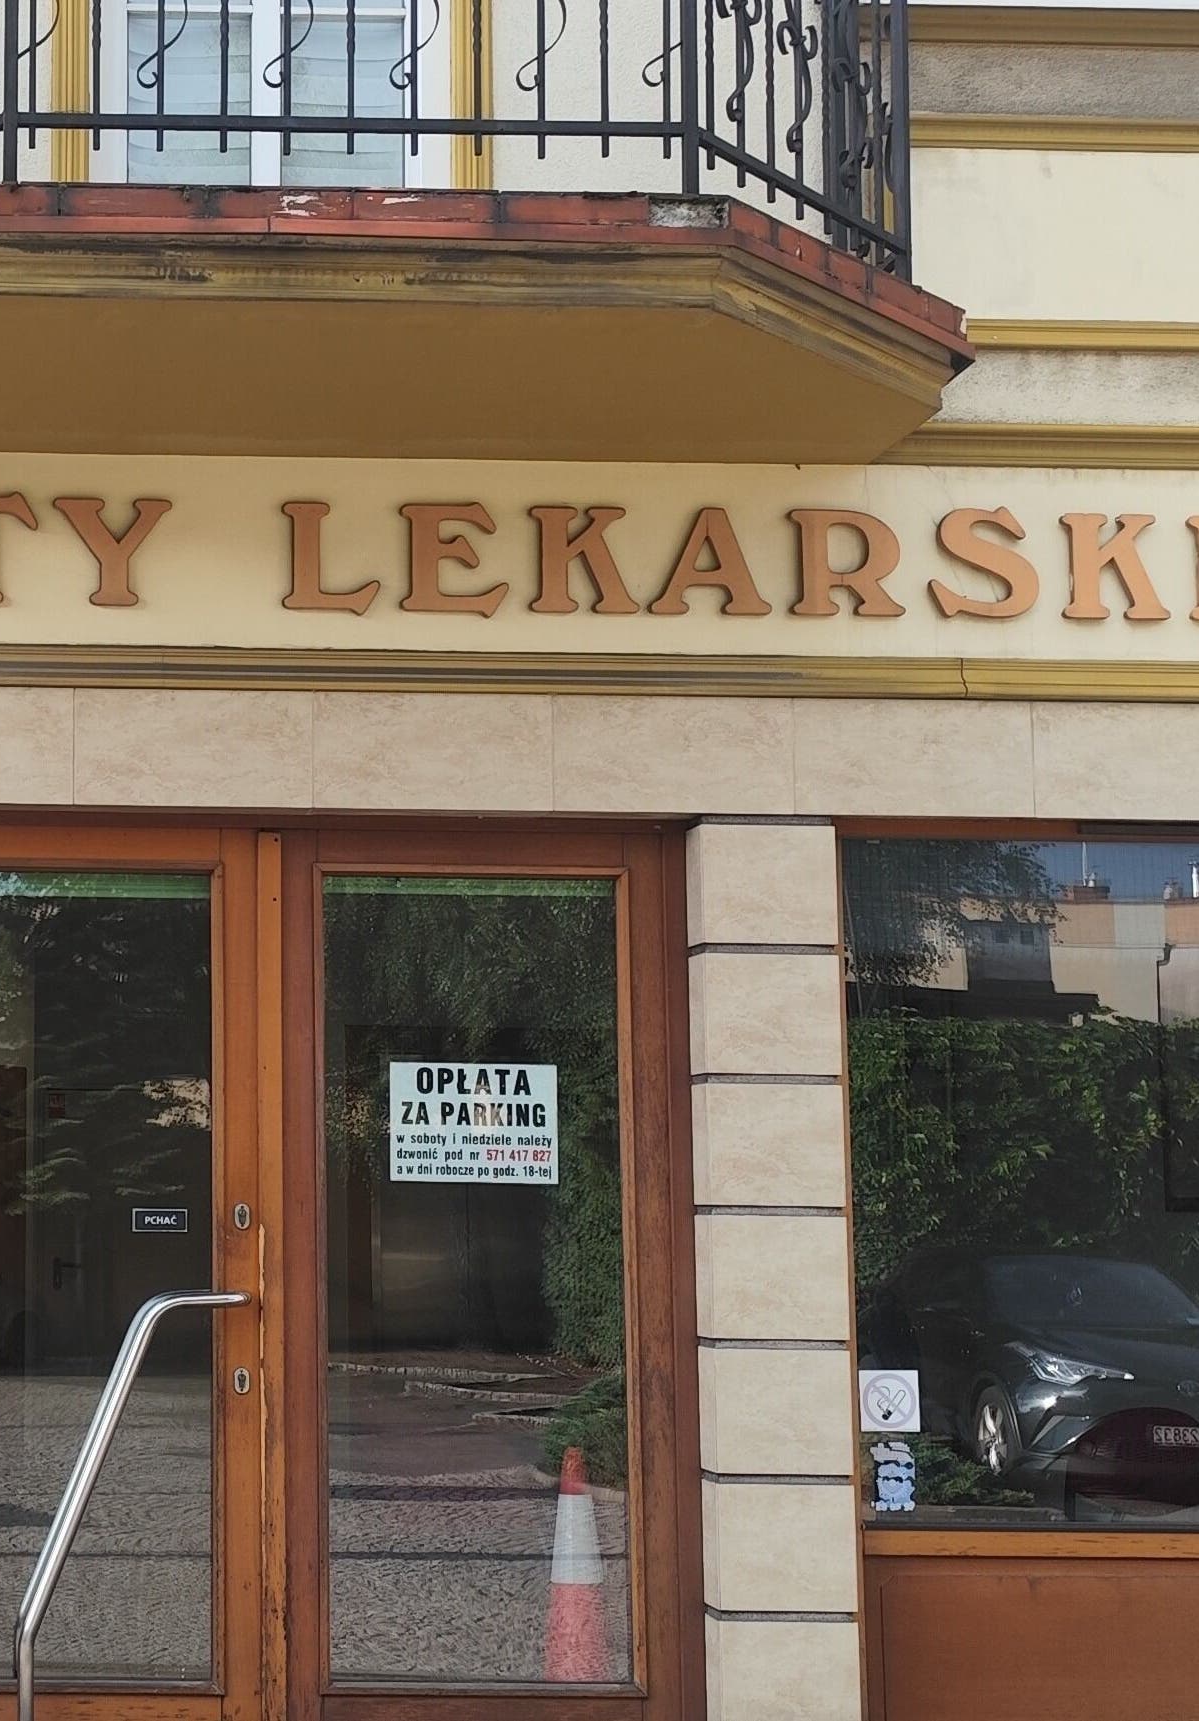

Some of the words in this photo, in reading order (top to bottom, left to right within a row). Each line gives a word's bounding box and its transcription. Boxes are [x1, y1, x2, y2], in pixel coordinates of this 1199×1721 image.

[416, 1067, 532, 1096] OPŁATA
[401, 1101, 430, 1125] ZA
[440, 1102, 546, 1128] PARKING
[396, 1134, 405, 1143] w
[410, 1132, 447, 1146] soboty
[452, 1132, 456, 1145] i
[462, 1132, 512, 1145] niedziele
[517, 1134, 552, 1149] należy
[396, 1147, 438, 1160] dzwonić
[444, 1149, 463, 1162] pod
[469, 1151, 480, 1161] nr
[486, 1149, 505, 1161] 571
[509, 1149, 529, 1162] 417
[532, 1149, 552, 1162] 827
[396, 1165, 403, 1175] a
[406, 1165, 414, 1175] w
[417, 1163, 432, 1175] dni
[435, 1164, 475, 1176] robocze
[477, 1166, 490, 1178] po
[493, 1165, 519, 1179] godz.
[522, 1165, 552, 1180] 18-tej
[144, 1214, 178, 1225] PCHAĆ
